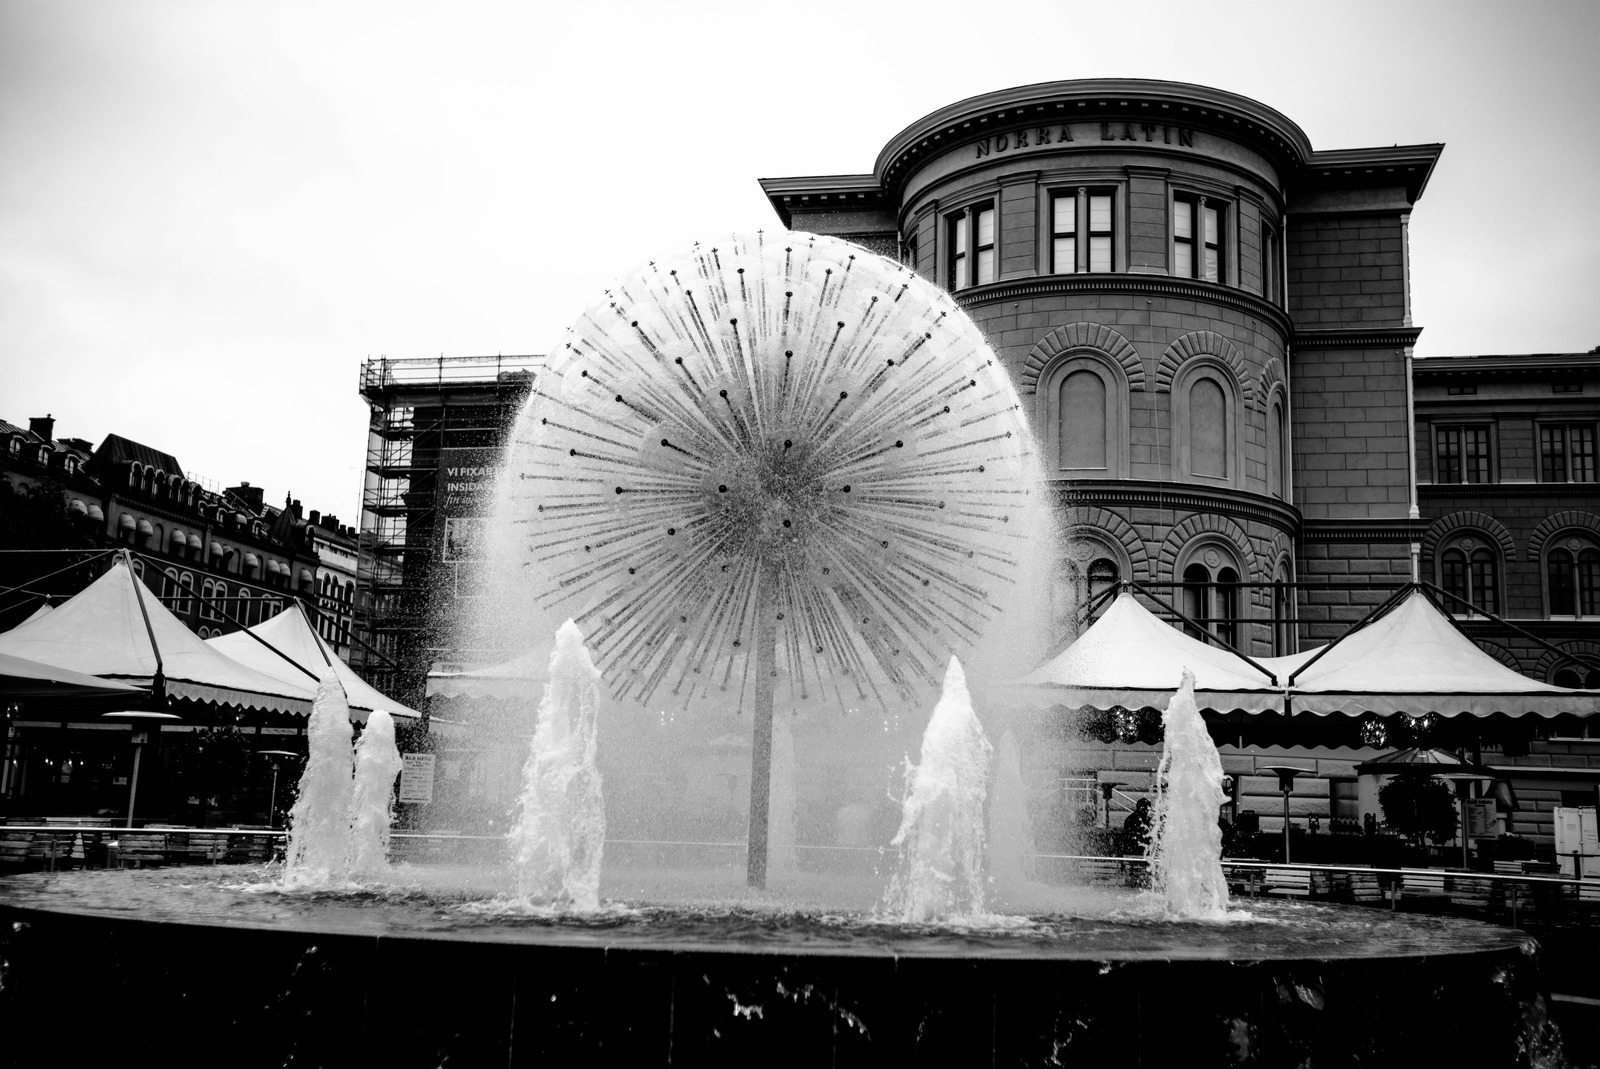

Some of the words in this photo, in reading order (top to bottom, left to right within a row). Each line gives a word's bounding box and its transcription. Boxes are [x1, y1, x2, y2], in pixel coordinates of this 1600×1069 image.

[975, 123, 1074, 159] NORRA
[1100, 121, 1194, 148] LATIN
[447, 467, 459, 477] VI
